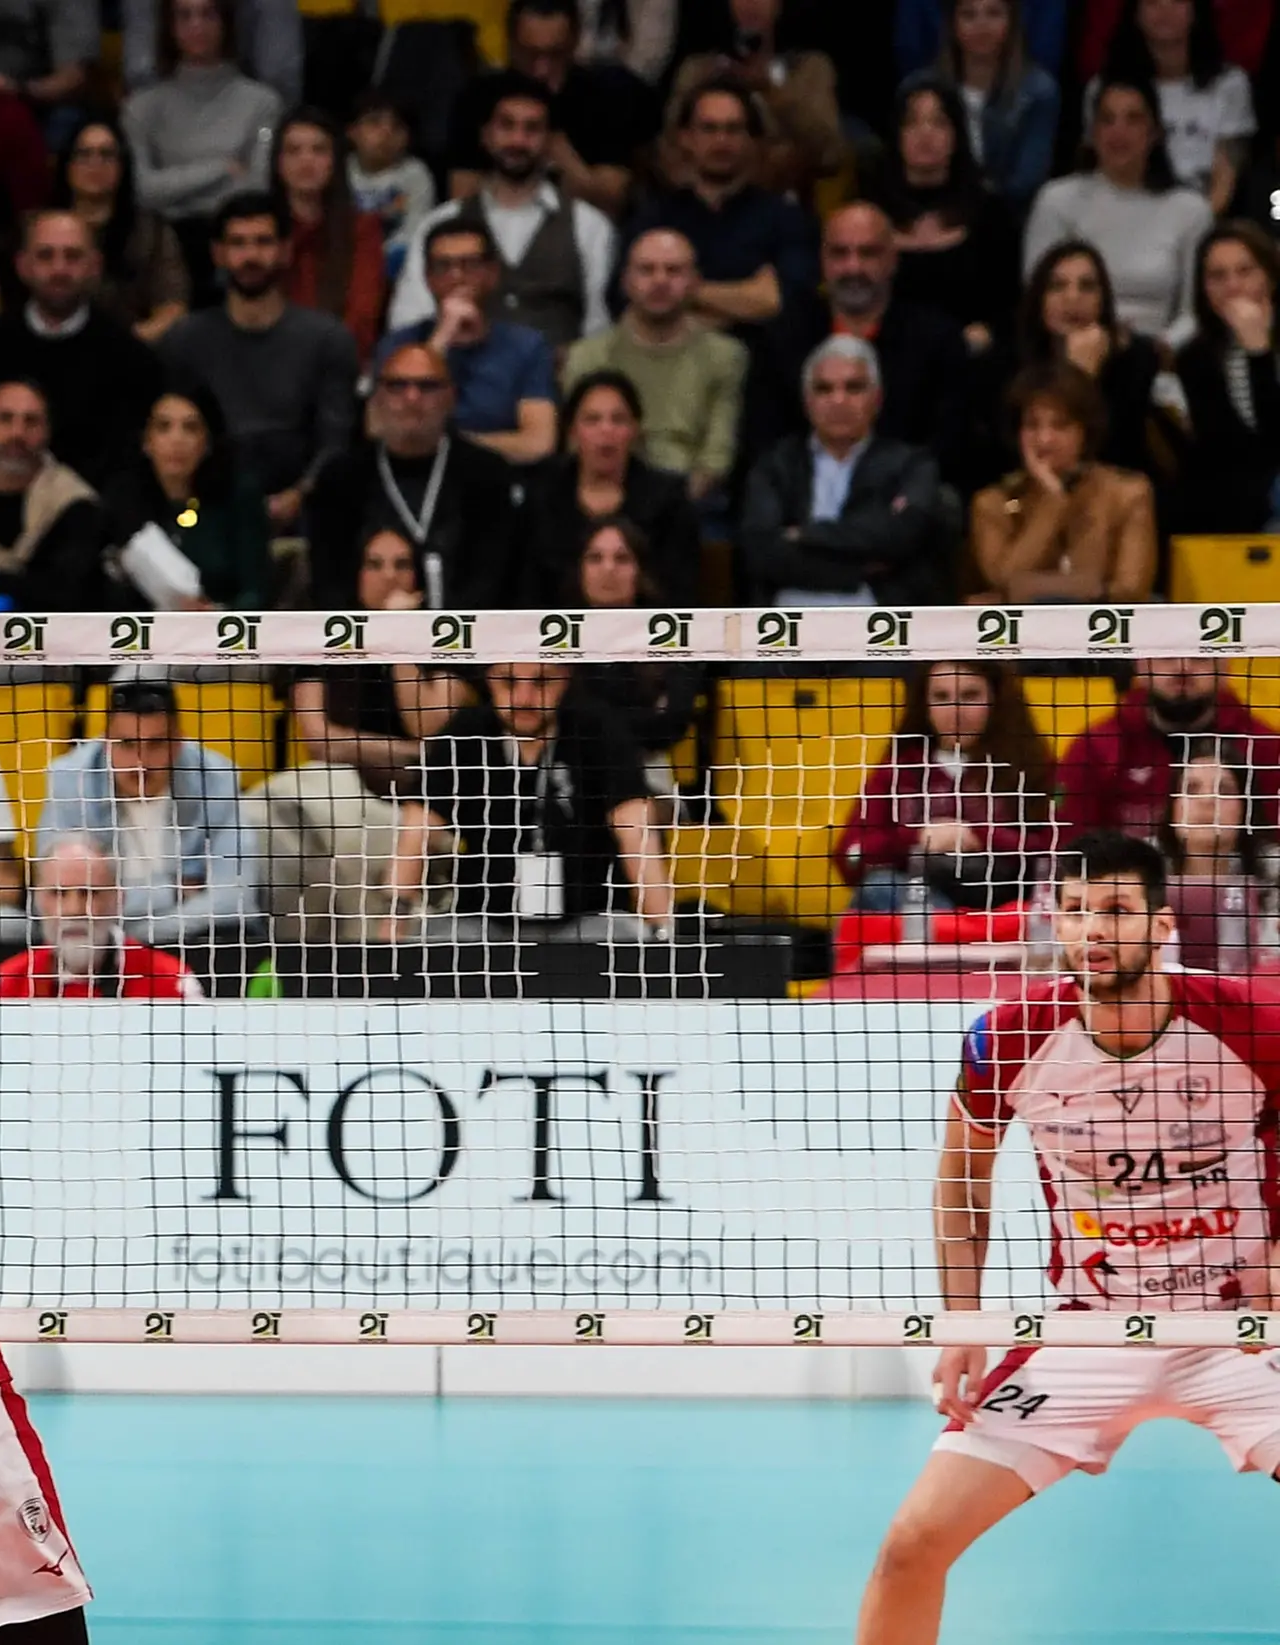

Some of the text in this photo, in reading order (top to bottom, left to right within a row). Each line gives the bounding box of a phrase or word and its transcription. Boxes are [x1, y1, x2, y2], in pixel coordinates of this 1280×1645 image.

[200, 1066, 677, 1203] FOTI
[1107, 1152, 1171, 1191] 24
[1104, 1208, 1239, 1248] CONAD
[170, 1238, 713, 1291] fotiboutique.com
[982, 1383, 1051, 1420] 24
